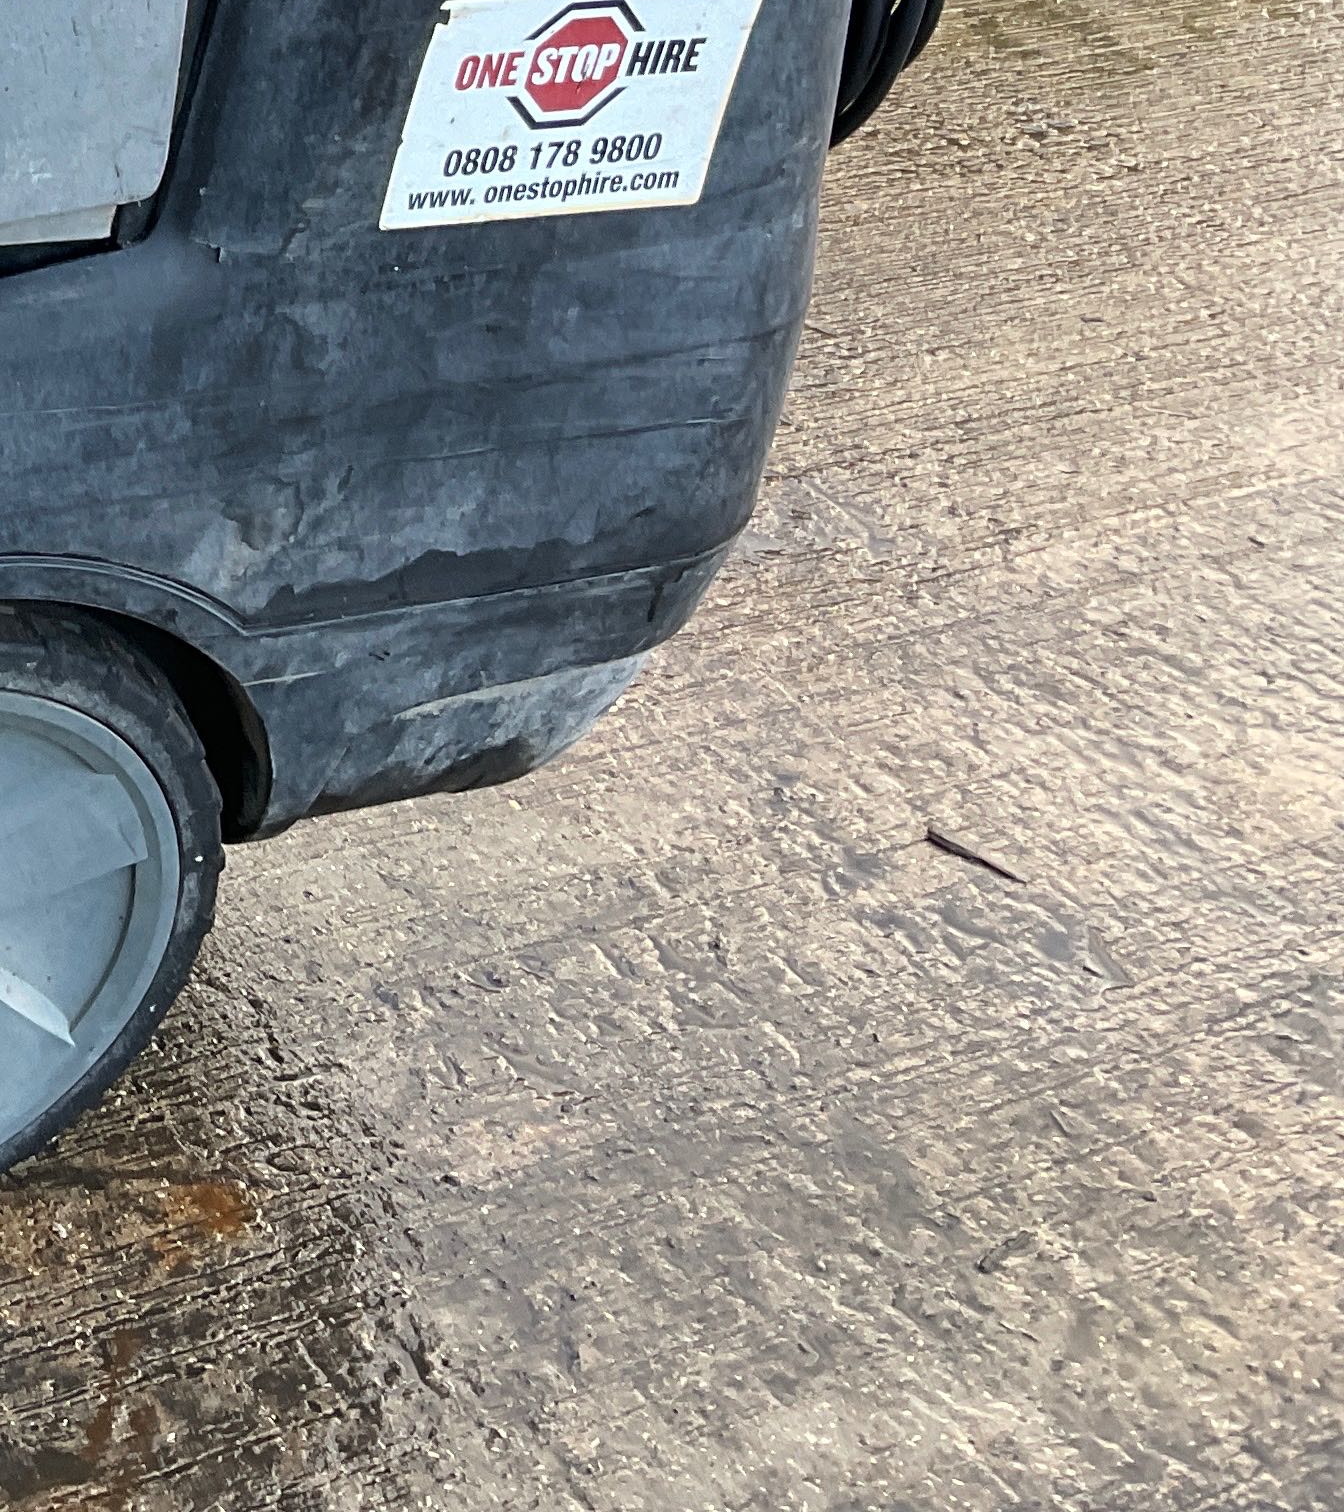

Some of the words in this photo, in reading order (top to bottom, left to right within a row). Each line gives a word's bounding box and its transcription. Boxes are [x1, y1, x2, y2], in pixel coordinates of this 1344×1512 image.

[455, 51, 525, 91] ONE
[531, 42, 621, 87] STOP
[626, 37, 708, 77] HIRE
[443, 146, 517, 177] 0808
[530, 139, 581, 170] 178
[590, 132, 663, 163] 9800
